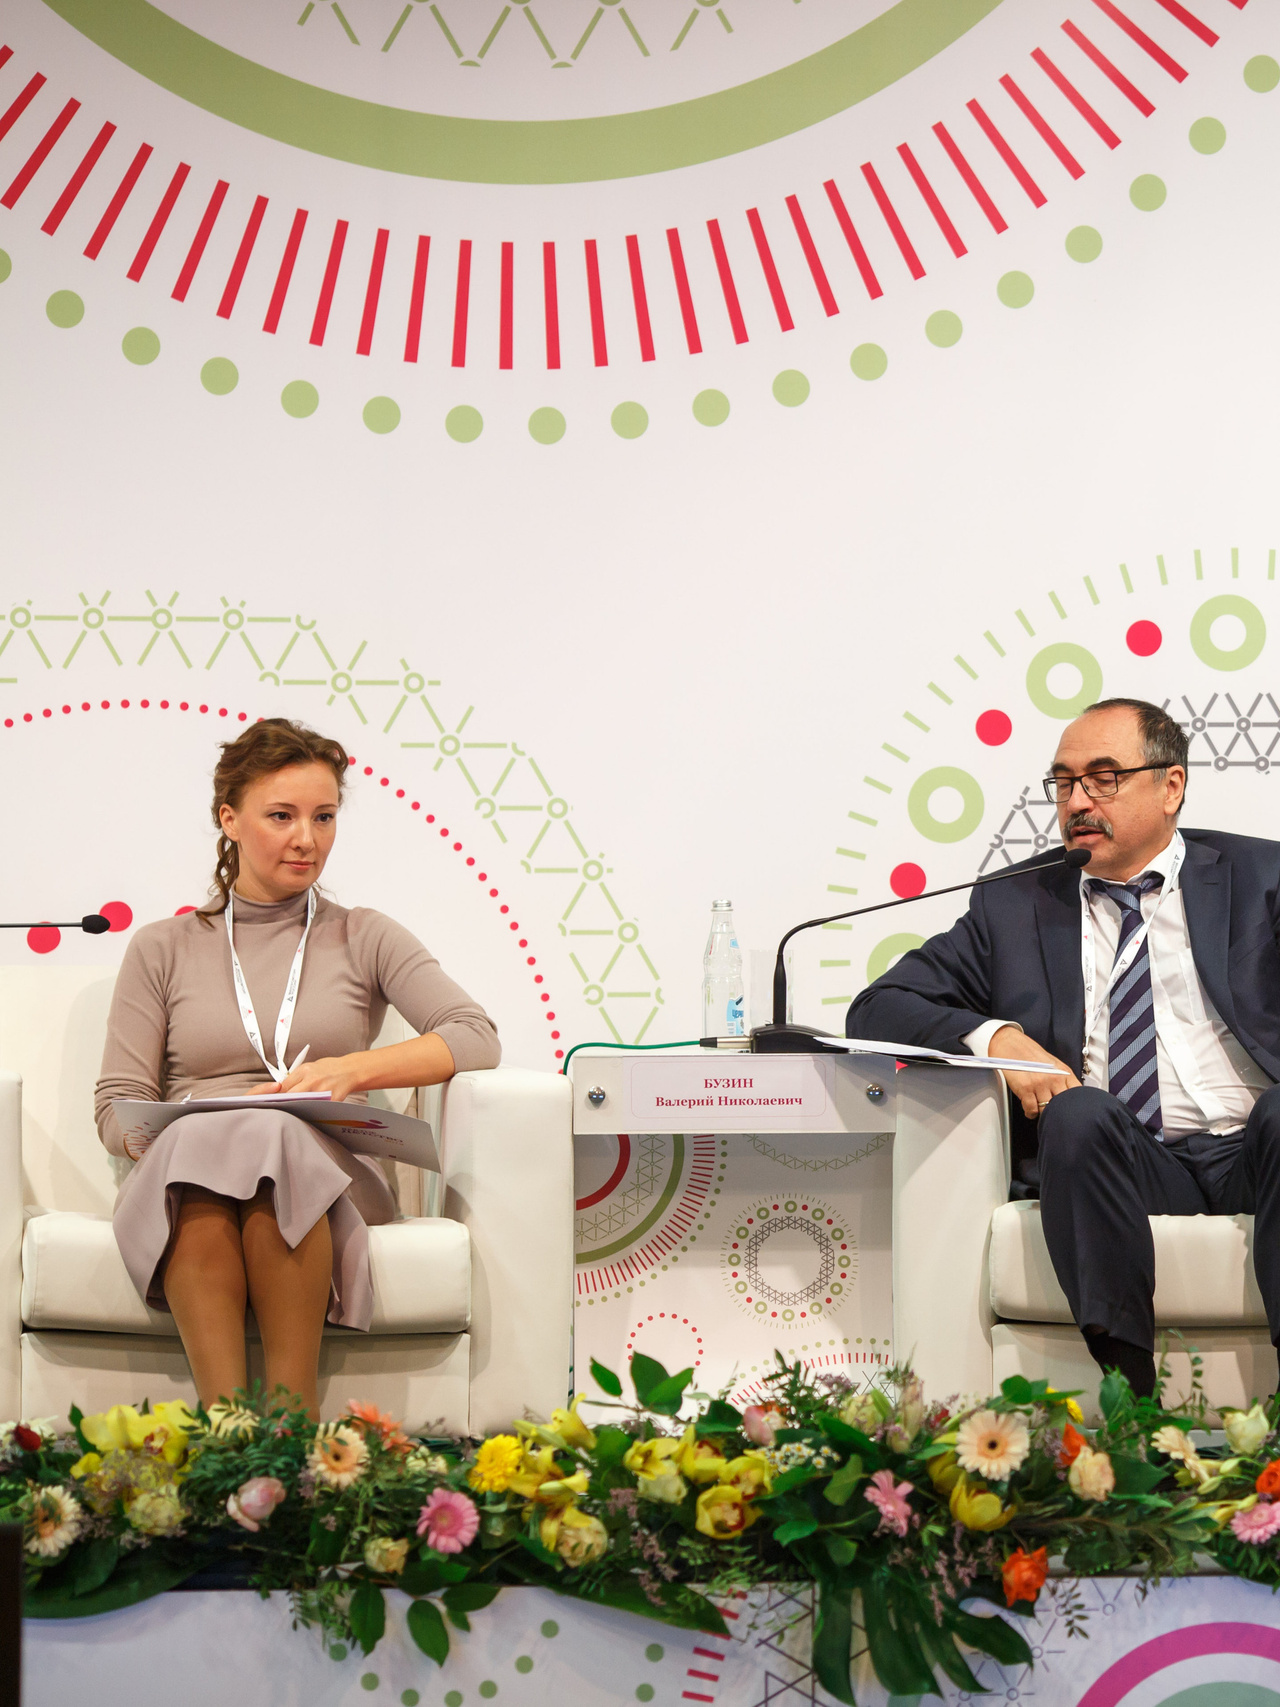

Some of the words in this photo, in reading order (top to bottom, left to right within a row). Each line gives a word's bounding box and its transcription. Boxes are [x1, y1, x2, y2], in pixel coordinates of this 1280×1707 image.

[703, 1078, 754, 1089] БУЗИН
[655, 1095, 714, 1109] Валерий
[717, 1095, 803, 1107] Николаевич
